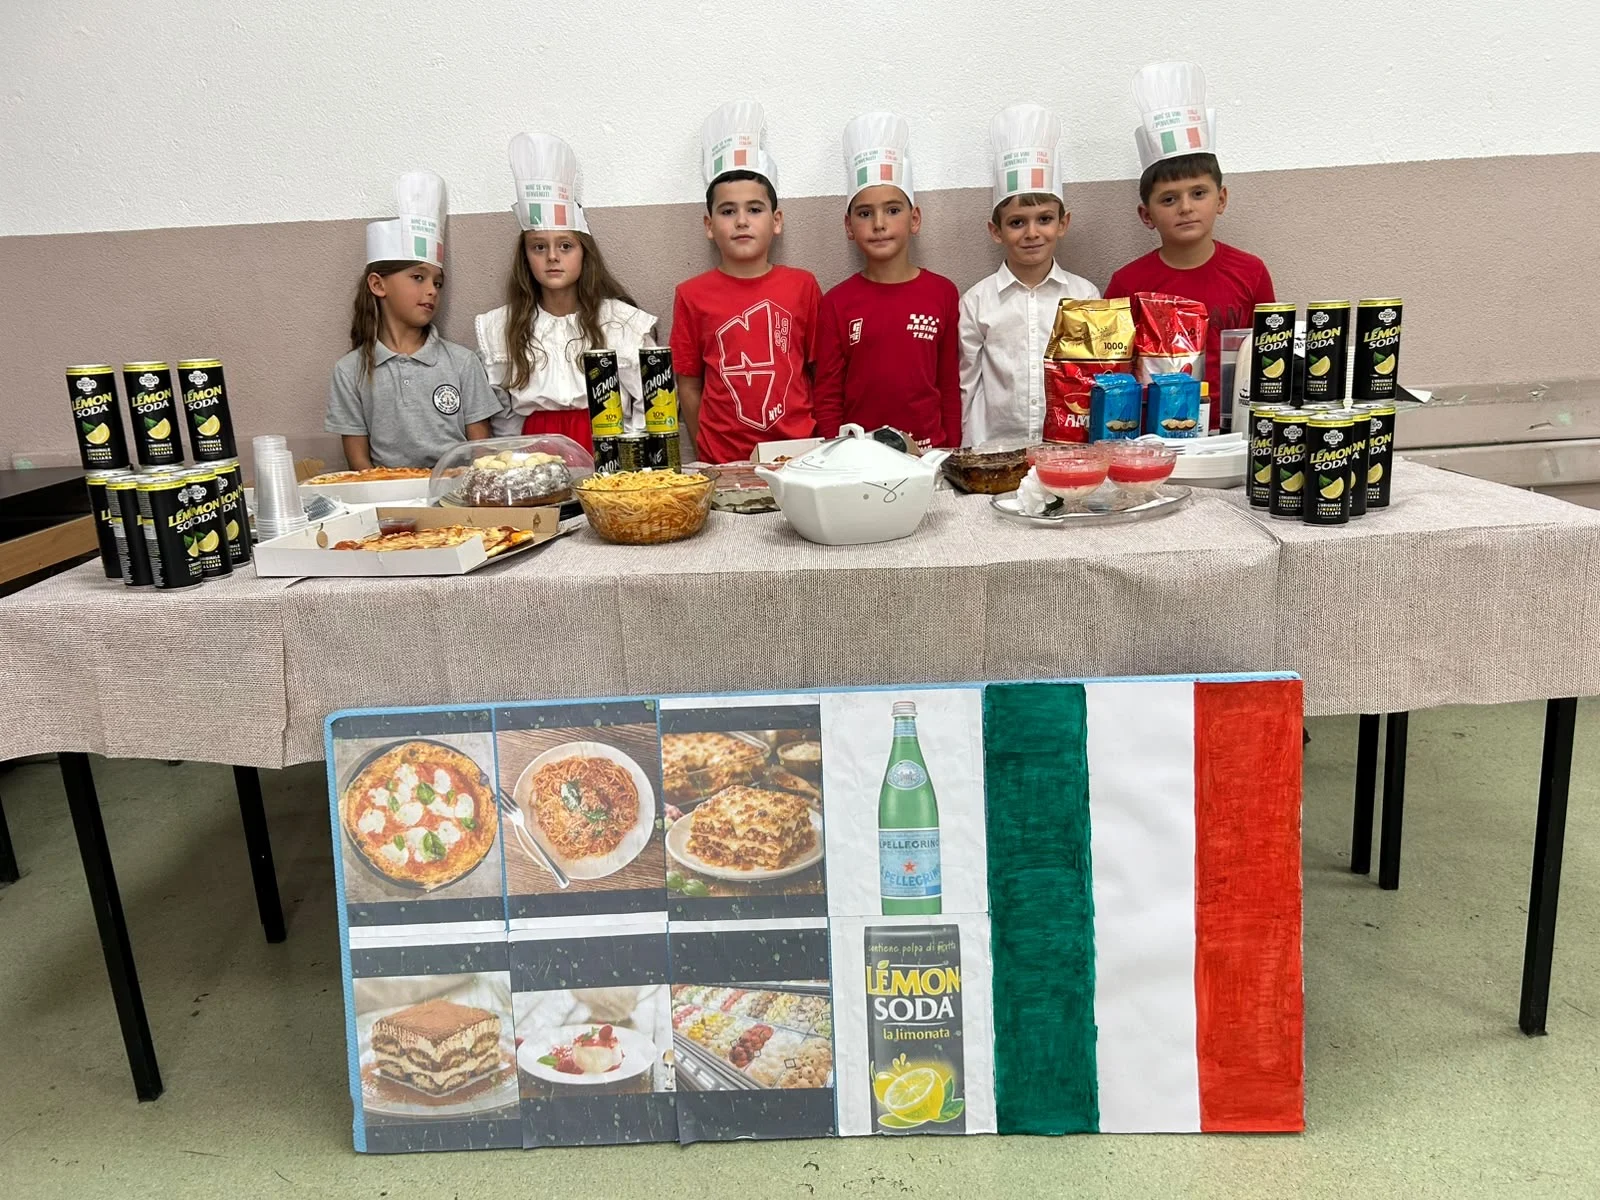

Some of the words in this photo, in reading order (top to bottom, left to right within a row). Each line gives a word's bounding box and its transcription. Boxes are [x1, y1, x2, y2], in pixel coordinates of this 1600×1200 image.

[906, 323, 938, 334] RASING
[912, 331, 934, 341] TEAM
[1368, 336, 1399, 349] SODA
[1258, 340, 1289, 353] SODA
[1306, 338, 1335, 351] SODA
[592, 371, 618, 400] LEMON
[137, 400, 169, 414] SODA
[188, 397, 219, 411] SODA
[76, 405, 109, 418] SODA
[1251, 447, 1271, 457] SOD
[1273, 443, 1306, 457] LEMO
[1314, 458, 1348, 471] SODA
[902, 942, 922, 956] polpa
[925, 939, 935, 951] di
[874, 996, 955, 1021] SODA
[883, 1028, 893, 1040] la
[895, 1028, 950, 1041] limonata
